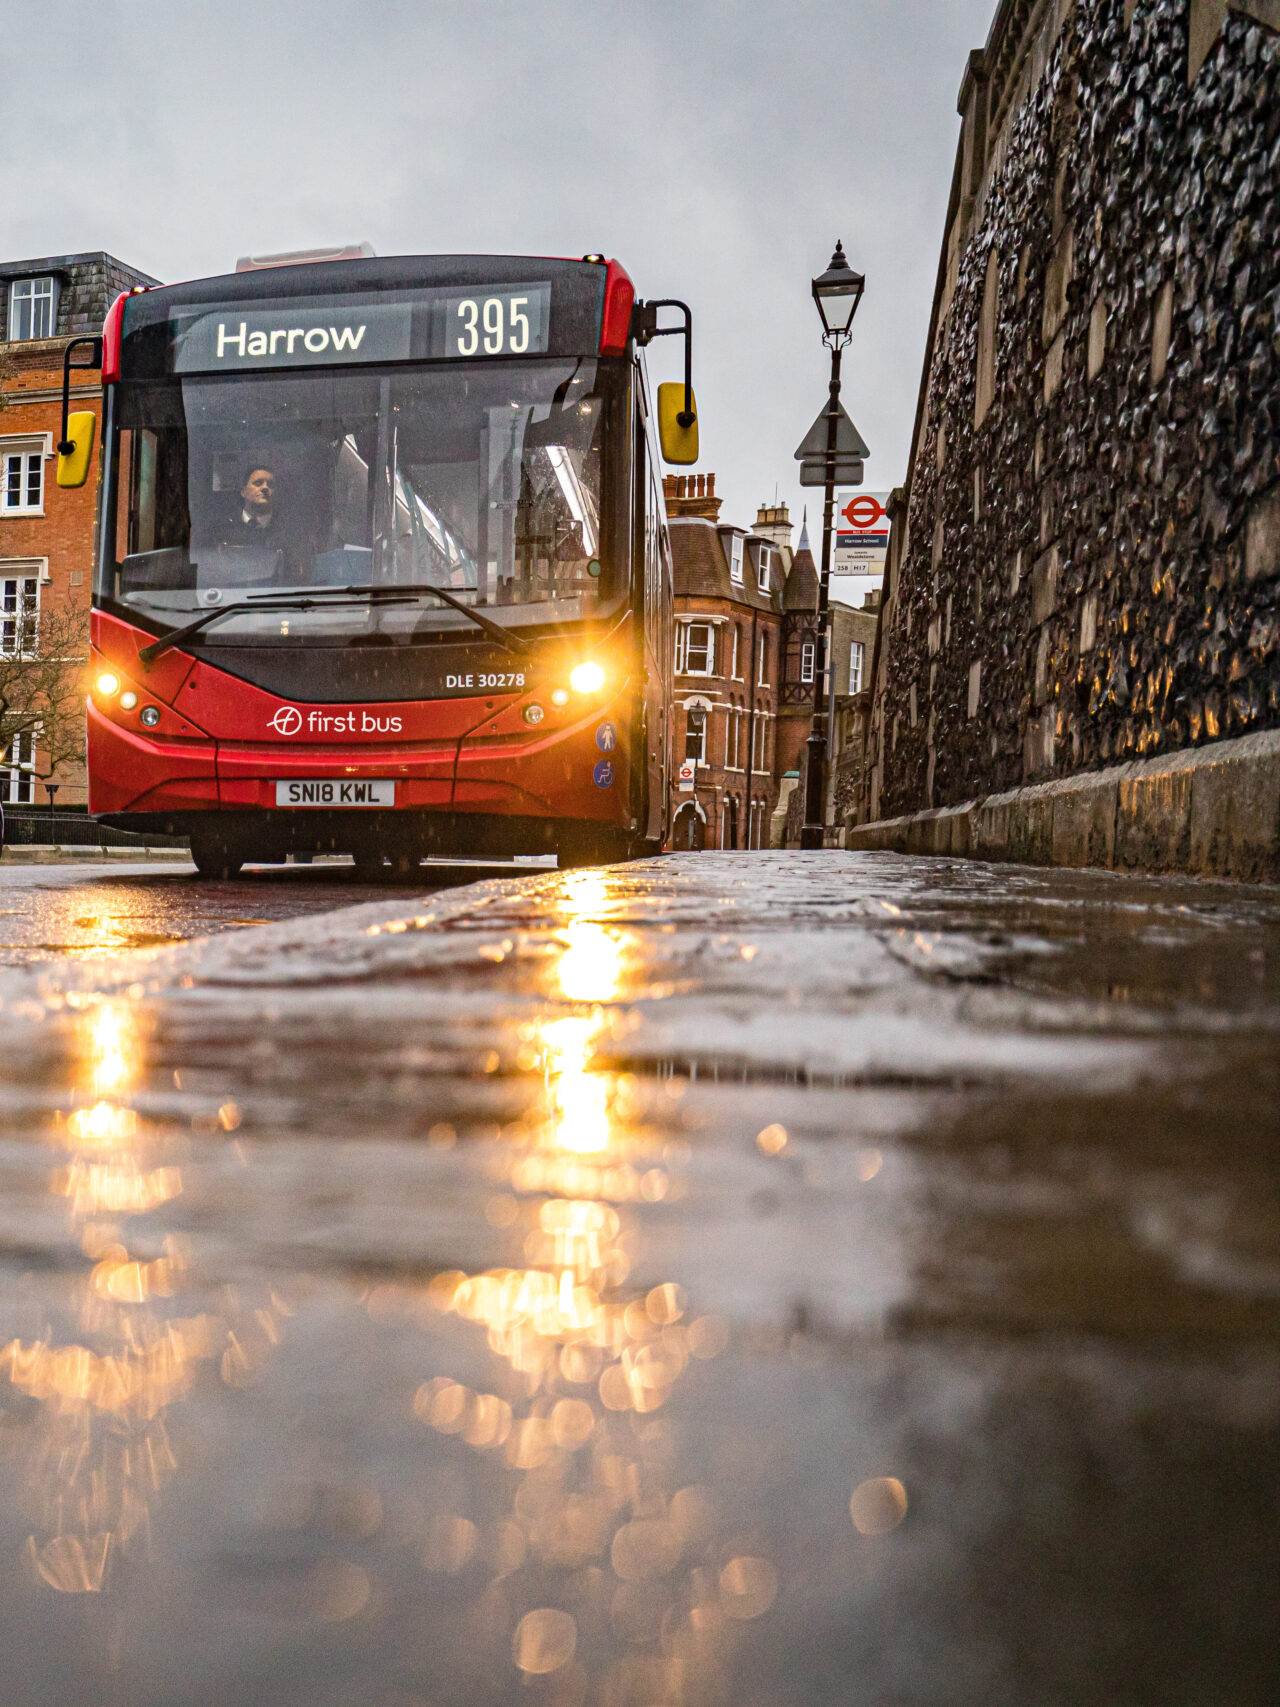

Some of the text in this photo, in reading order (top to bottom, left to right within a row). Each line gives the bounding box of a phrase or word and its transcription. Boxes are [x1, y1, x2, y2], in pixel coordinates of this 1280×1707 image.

[456, 297, 530, 356] 395
[216, 322, 367, 358] Harrow
[446, 673, 525, 688] DLE 30278
[307, 711, 402, 732] first bus
[289, 784, 380, 802] SN18 KWL
